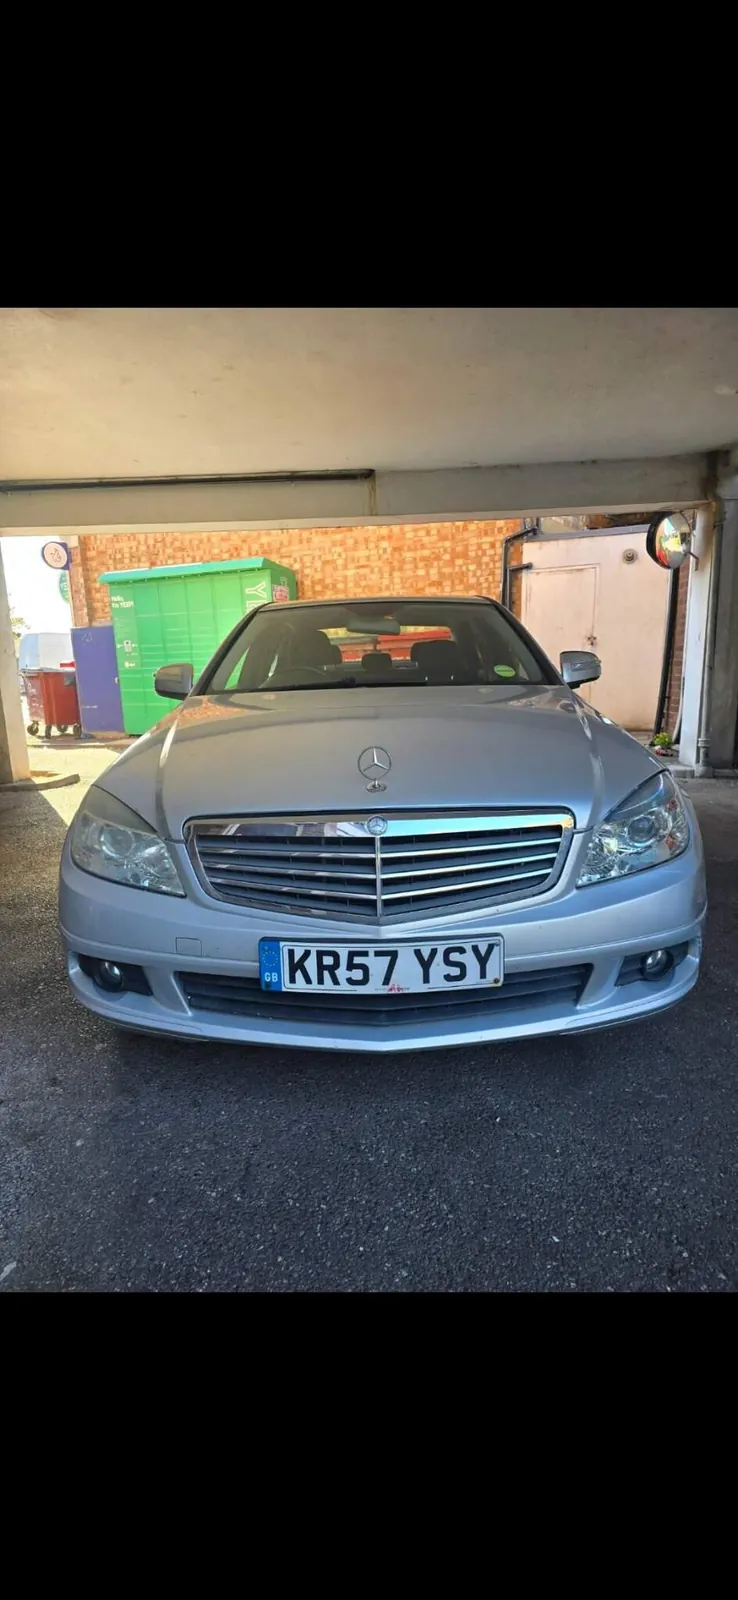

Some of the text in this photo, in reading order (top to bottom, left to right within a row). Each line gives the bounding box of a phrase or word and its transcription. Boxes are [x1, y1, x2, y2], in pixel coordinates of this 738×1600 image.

[264, 972, 279, 982] GB
[287, 943, 496, 986] KR57 YSY
